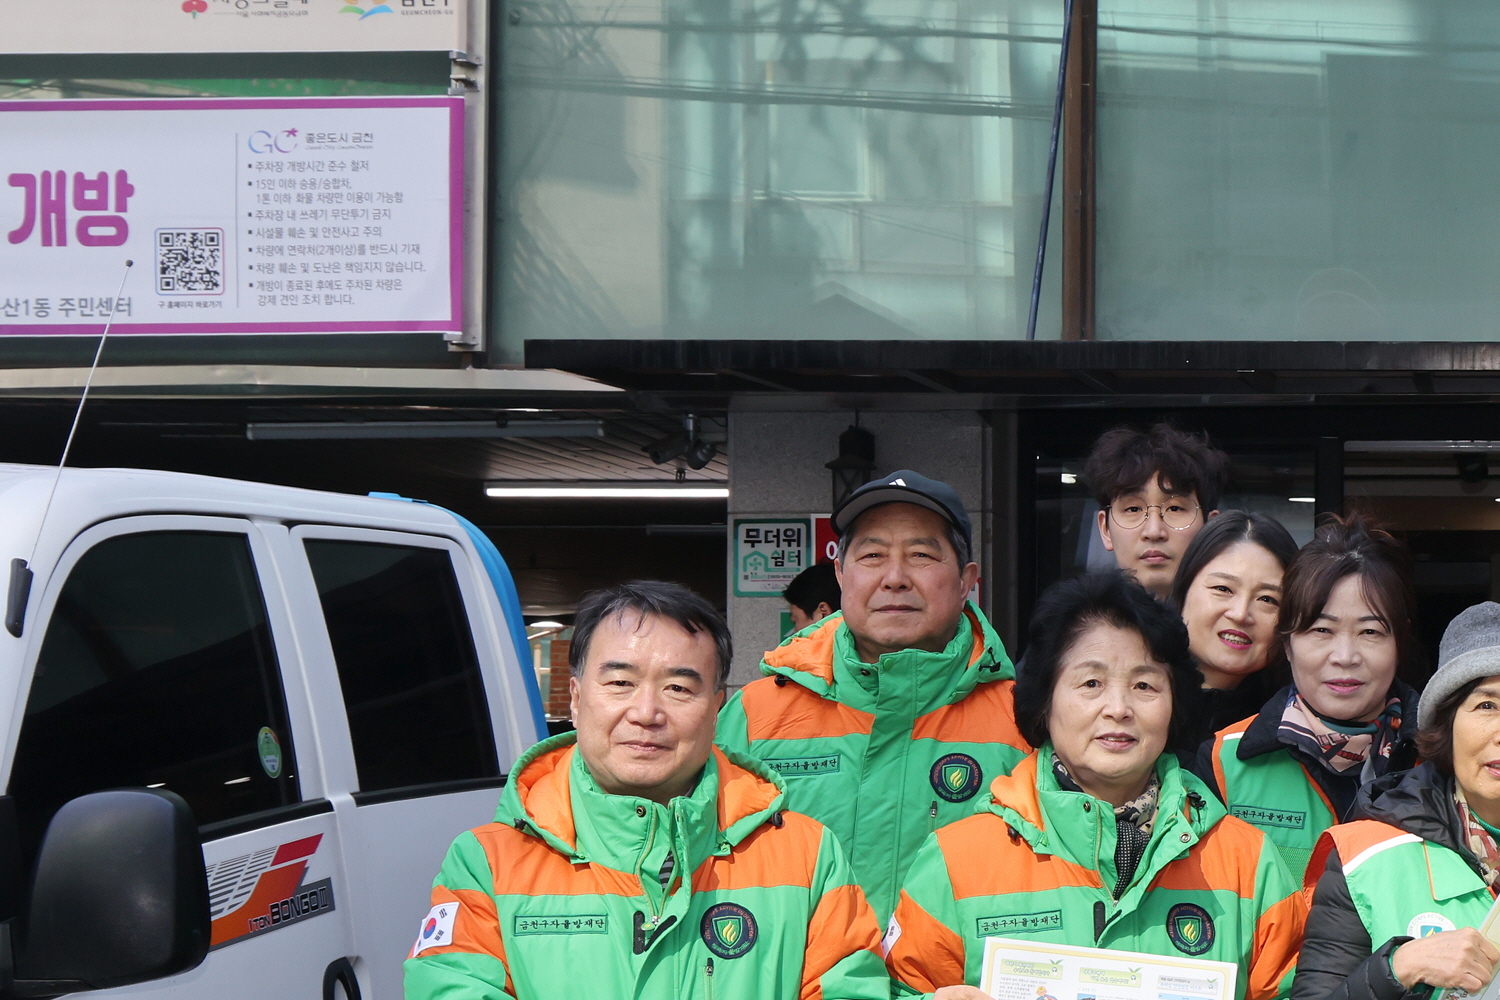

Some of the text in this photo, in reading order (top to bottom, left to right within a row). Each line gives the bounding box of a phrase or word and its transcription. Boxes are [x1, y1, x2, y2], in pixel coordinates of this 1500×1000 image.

[305, 132, 374, 144] 좋은도시 금천
[255, 160, 370, 172] 주차장 개방시간 준수 철저
[256, 179, 275, 190] 15인
[278, 179, 296, 190] 이하
[256, 192, 404, 205] 1톤 이하 화물 차량만 이용이 가능함
[8, 169, 135, 248] 개방
[255, 209, 392, 221] 주차장 내 쓰레기 무단투기 금지
[255, 226, 382, 239] 시설물 훼손 및 안전사고 주의
[255, 245, 284, 256] 차량에
[369, 244, 398, 255] 반드시
[401, 243, 421, 254] 기재
[255, 261, 427, 274] 차량 훼손 및 도난은 책임지지 않습니다.
[256, 279, 403, 291] 개방이 종료된 후에도 주차된 차량은
[257, 294, 355, 306] 강제 견인 조치 합니다.
[57, 297, 132, 317] 주민센터
[743, 528, 802, 548] 무더위
[771, 550, 801, 567] 쉼터
[1233, 809, 1302, 823] 금천구자율방재단
[519, 919, 605, 931] 금천구자율방재단
[981, 914, 1060, 930] 금천구자율방재단
